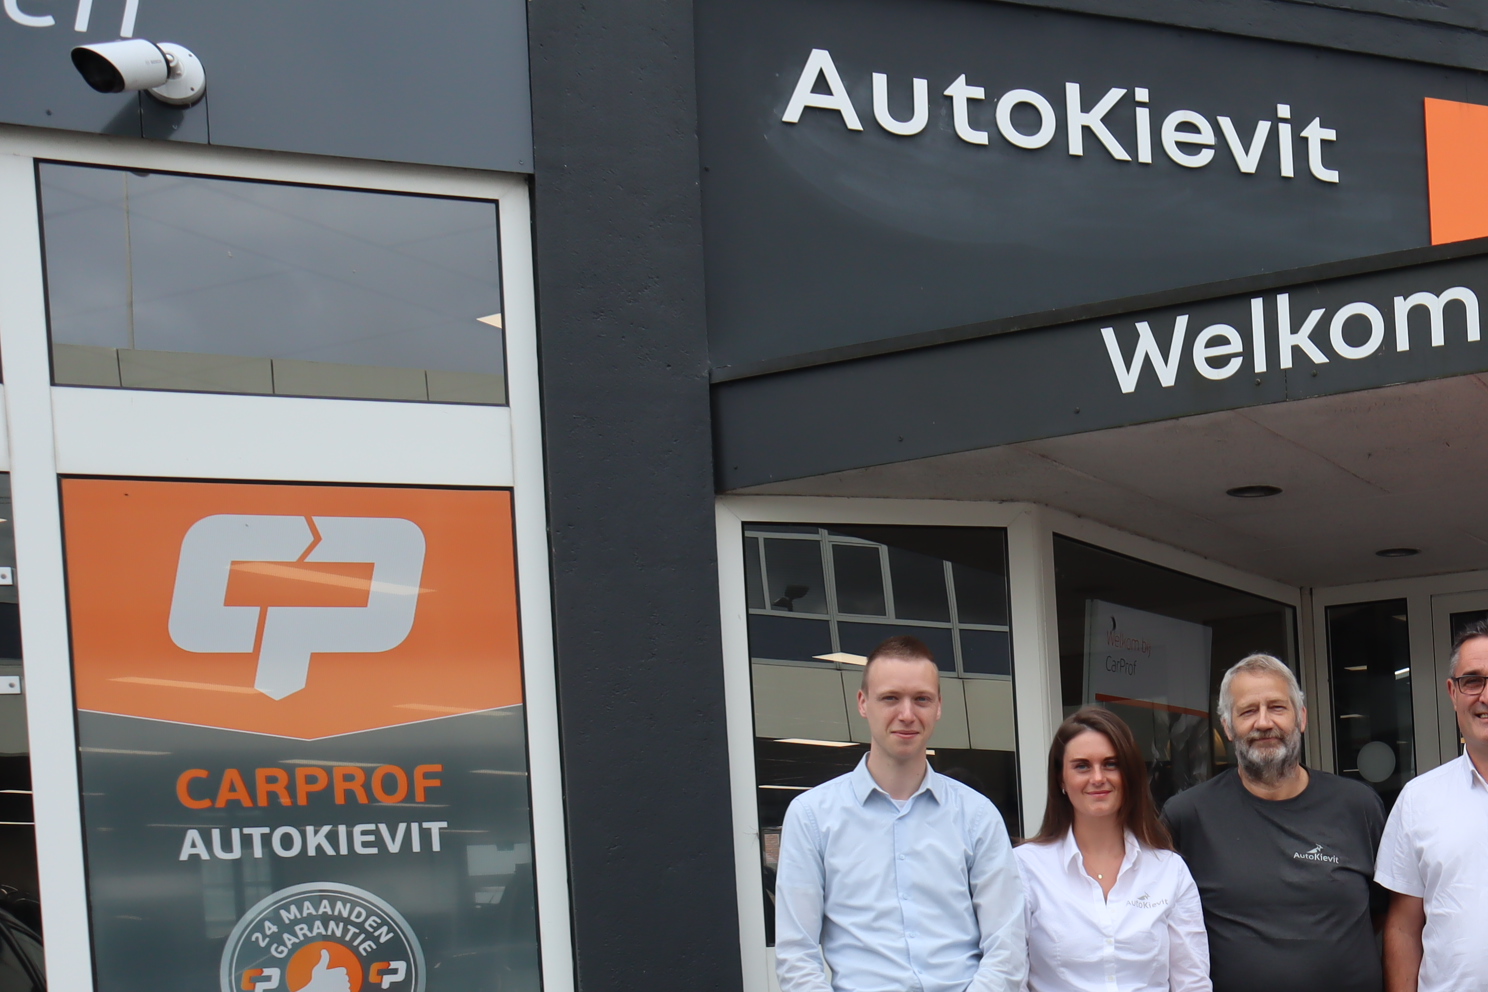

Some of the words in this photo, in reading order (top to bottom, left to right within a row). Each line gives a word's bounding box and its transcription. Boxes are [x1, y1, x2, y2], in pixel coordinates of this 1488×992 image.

[781, 48, 1340, 184] AutoKievit
[1100, 286, 1481, 394] Welkom
[1106, 630, 1140, 651] Welkom
[1105, 655, 1137, 676] CarProf
[176, 763, 444, 810] CARPROF
[178, 821, 448, 861] AUTOKIEVIT
[1293, 851, 1340, 865] AutoKievit
[1126, 898, 1169, 909] AutoKievit
[252, 919, 279, 948] 24
[279, 899, 394, 944] MAANDEN
[270, 920, 377, 959] GARANTIE
